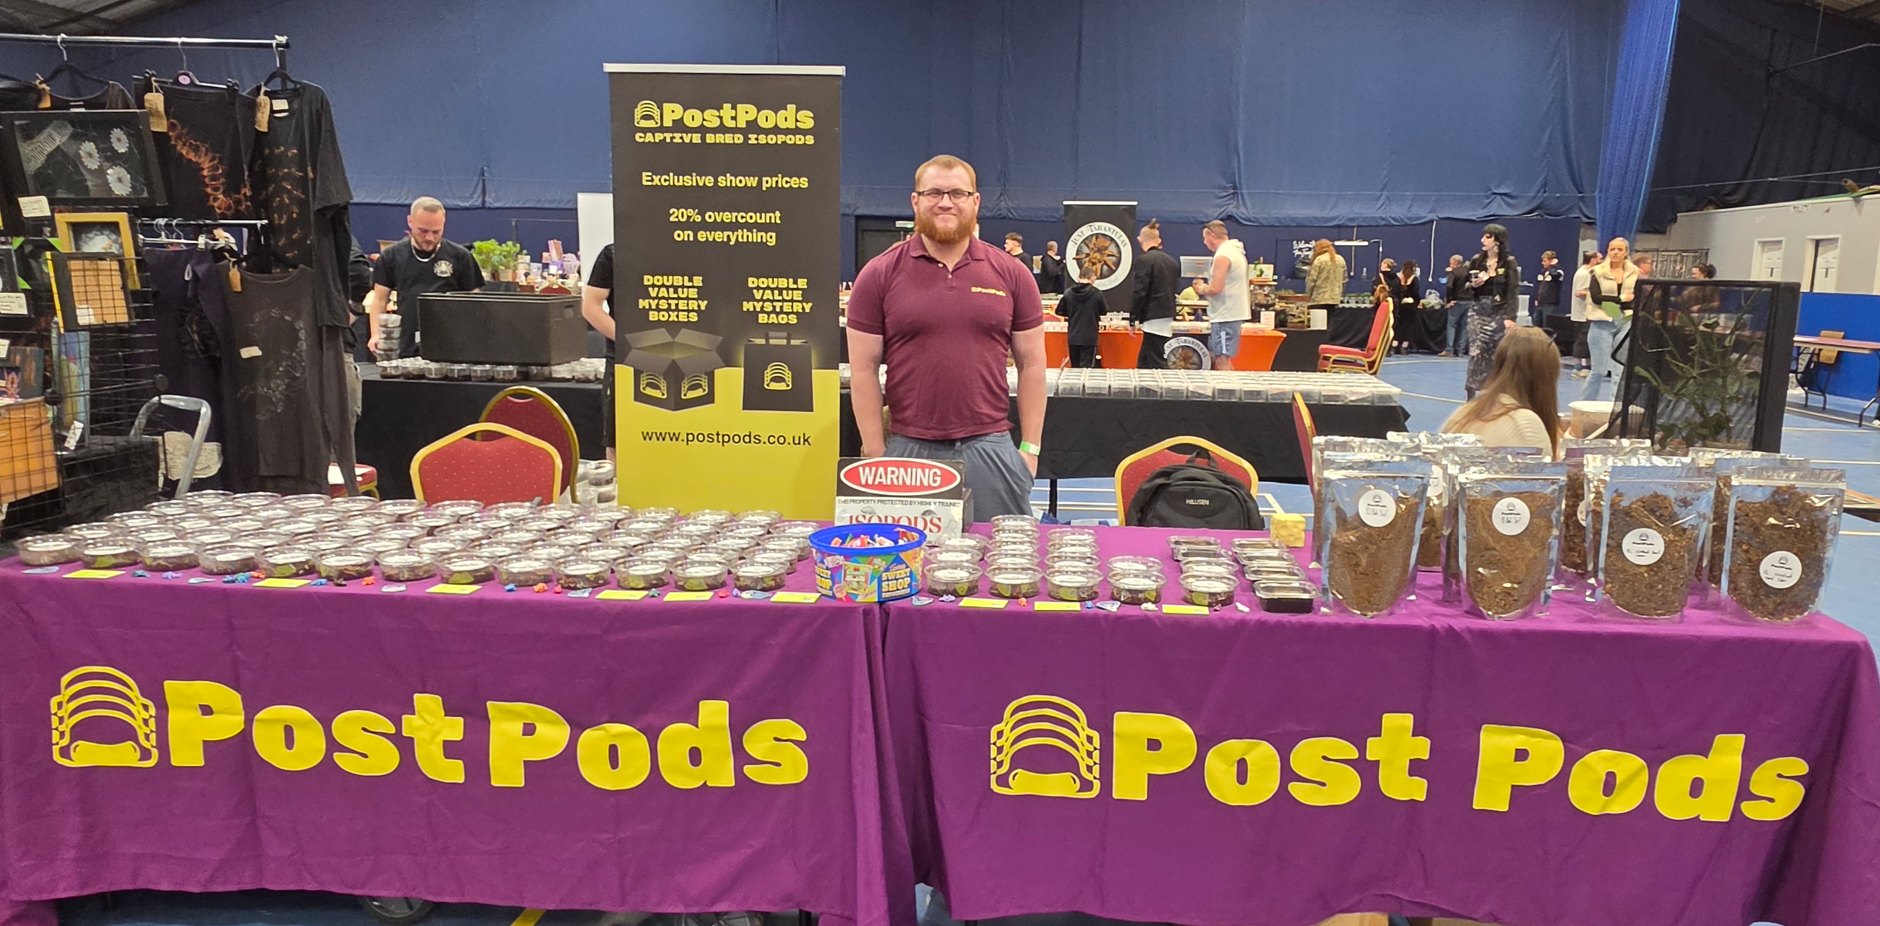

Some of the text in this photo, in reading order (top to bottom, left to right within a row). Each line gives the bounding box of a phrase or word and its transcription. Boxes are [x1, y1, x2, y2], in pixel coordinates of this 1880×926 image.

[662, 103, 815, 129] PostPods
[635, 132, 815, 145] CAPTIVE BRED ISOPODS
[641, 171, 809, 191] Exclusive show prices
[669, 208, 781, 224] 20% overcount
[673, 228, 777, 246] on everything
[643, 275, 703, 287] DOUBLE
[747, 277, 808, 289] DOUBLE
[648, 287, 699, 299] VALUE
[752, 289, 803, 301] VALUE
[638, 299, 708, 311] MYSTERY
[742, 301, 813, 313] MYSTERY
[648, 311, 699, 323] BOXES
[758, 313, 798, 324] BAGS
[641, 430, 812, 447] www.postpods.co.uk
[858, 466, 942, 487] WARNING
[882, 577, 911, 592] SHOP
[1112, 710, 1811, 823] Post Pods
